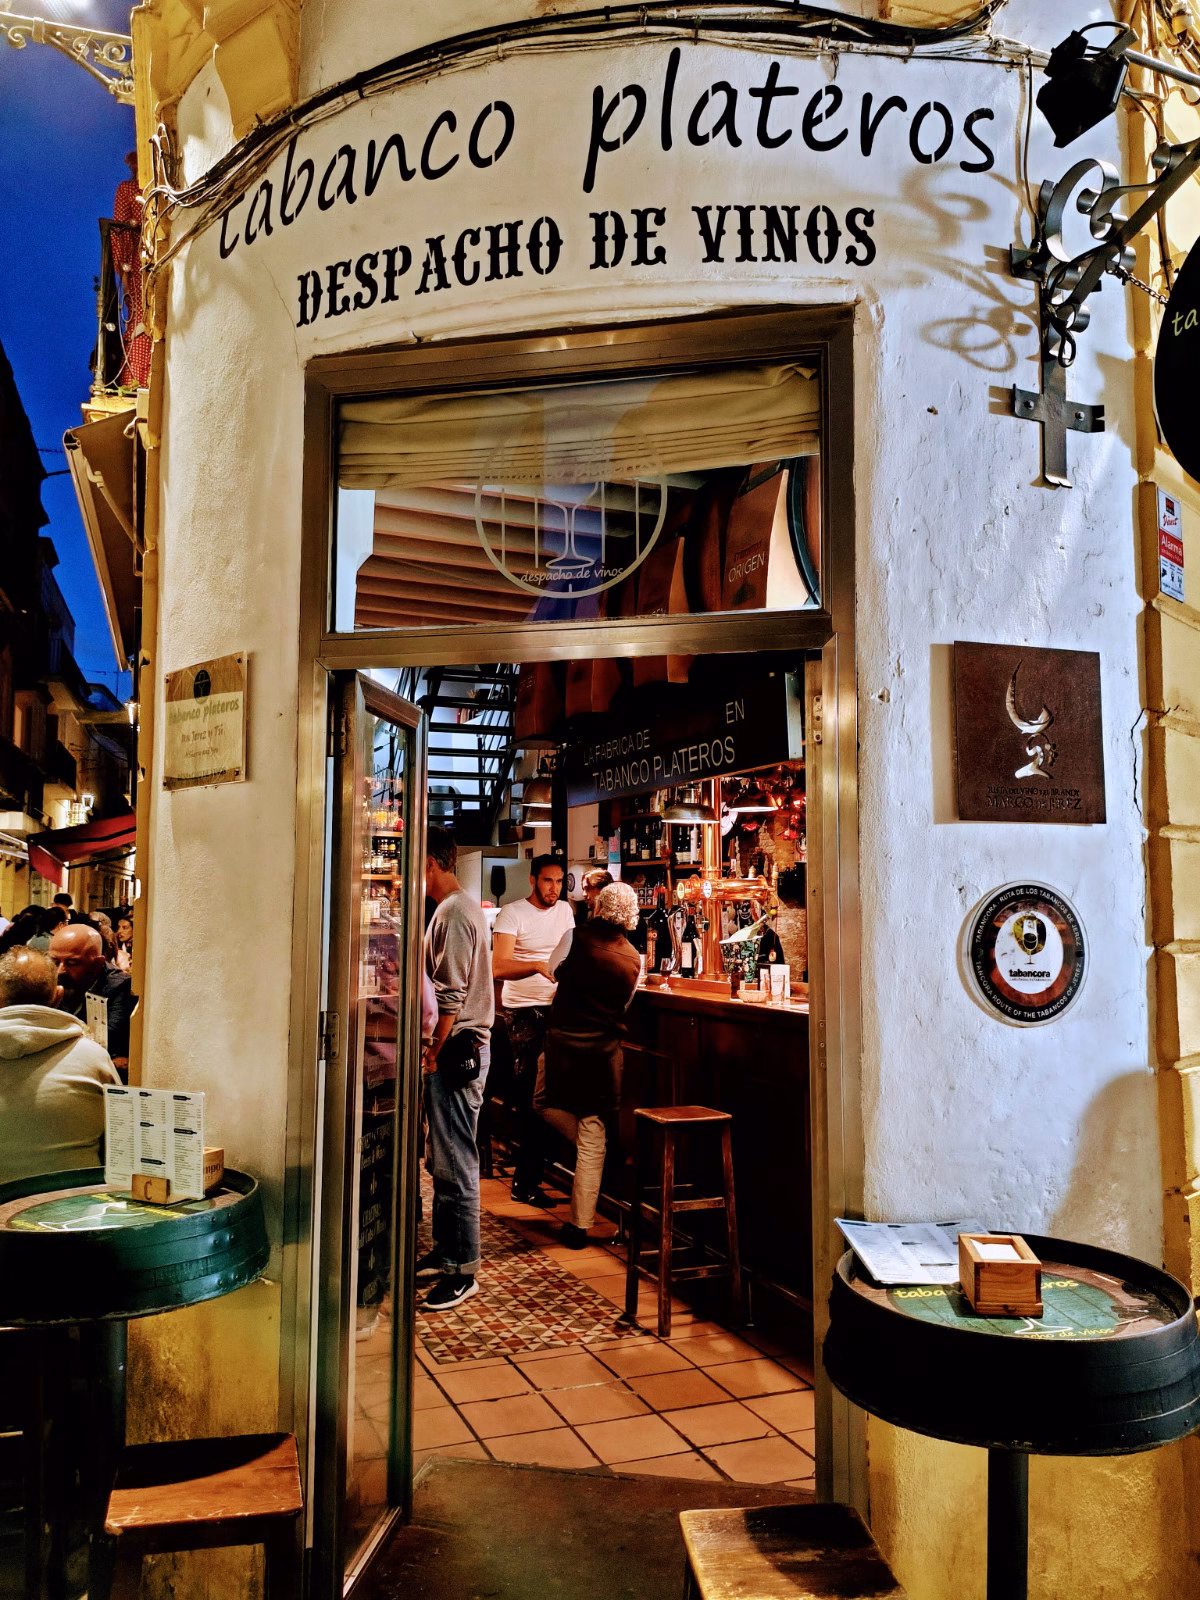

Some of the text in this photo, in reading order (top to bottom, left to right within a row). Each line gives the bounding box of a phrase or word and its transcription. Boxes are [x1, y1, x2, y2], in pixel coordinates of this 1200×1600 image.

[218, 47, 995, 260] tabanco plateros
[296, 205, 877, 328] DESPACHO DE VINOS
[1161, 534, 1183, 557] Alarma
[520, 565, 624, 588] despacho de vinos
[728, 551, 766, 583] ORIGEN
[635, 729, 651, 751] DE
[725, 698, 746, 725] EN
[592, 735, 736, 793] TABANCO PLATEROS
[987, 796, 1034, 809] MARCO
[1048, 797, 1082, 811] JEREZ
[1050, 788, 1080, 797] BRANDY
[976, 887, 1081, 947] TABANCORA RUTA DE LOS TABANCOS DE JEREZ
[1009, 968, 1051, 978] tabancora
[991, 995, 1012, 1013] ROUTE
[1013, 1009, 1023, 1017] OF
[1023, 1011, 1036, 1019] THE
[1036, 995, 1068, 1017] TABANCOS
[1066, 987, 1075, 997] OF
[1072, 963, 1082, 988] JEREZ
[893, 1287, 963, 1299] taban
